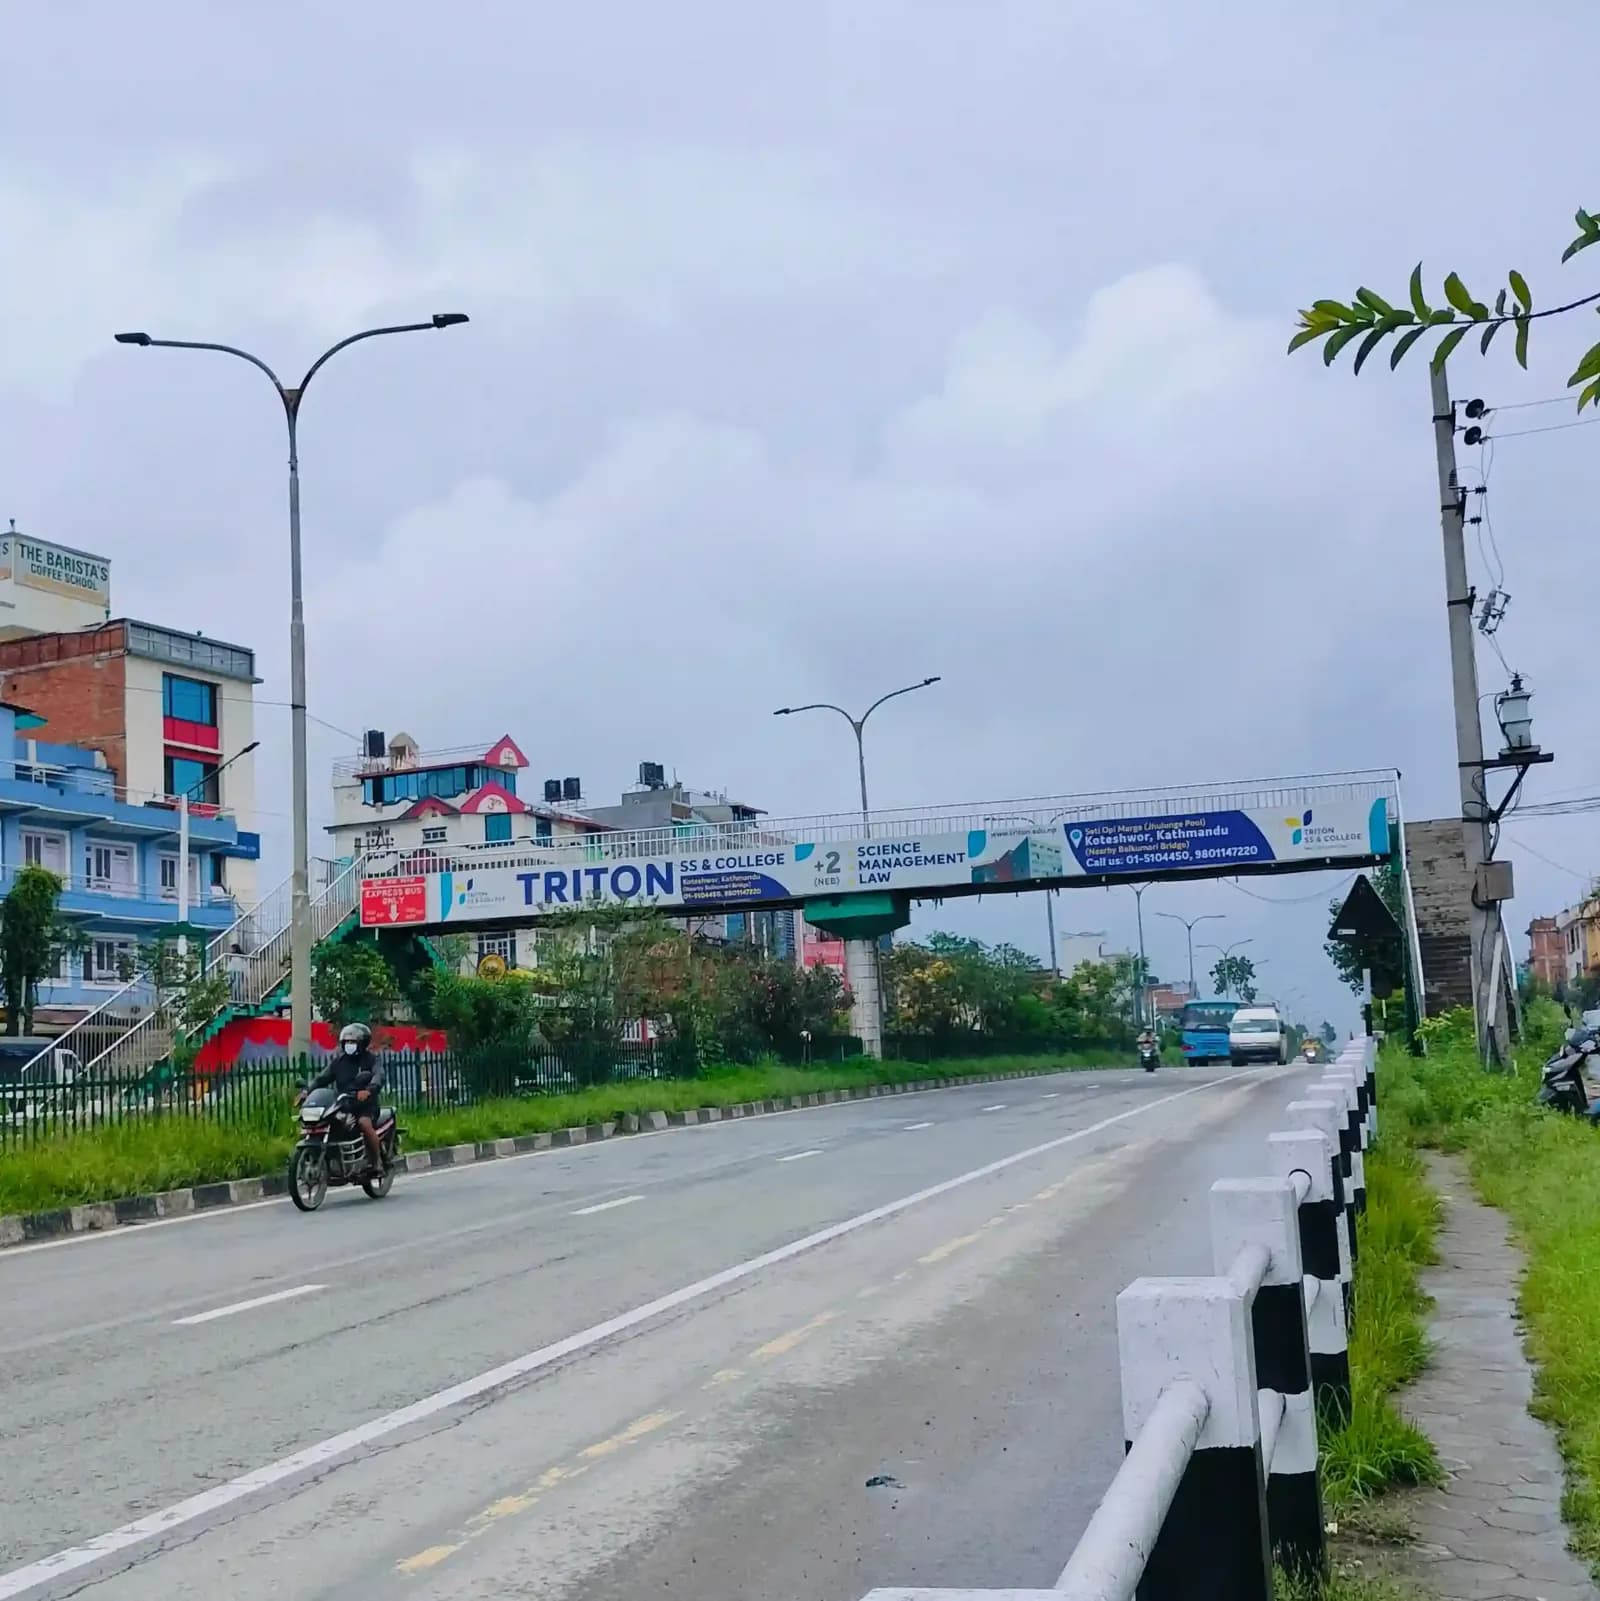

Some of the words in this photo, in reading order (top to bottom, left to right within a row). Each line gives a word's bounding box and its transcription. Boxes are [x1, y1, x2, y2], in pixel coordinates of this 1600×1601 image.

[19, 543, 42, 563] THE
[46, 551, 108, 581] BARISTA'S
[31, 563, 61, 581] COFFEE
[65, 572, 99, 591] SCHOOL
[1085, 833, 1154, 846] Koteshwor,
[1156, 825, 1229, 840] Kathmandu
[1304, 827, 1335, 836] TRITON
[1304, 836, 1314, 844] SS
[1323, 833, 1362, 842] COLLEGE
[857, 842, 921, 857] SCIENCE
[1086, 857, 1106, 868] Call
[1126, 851, 1193, 865] 01-5104450,
[1195, 845, 1258, 859] 9801147220
[680, 860, 697, 873] SS
[702, 858, 712, 871] &
[715, 853, 785, 869] COLLEGE
[814, 851, 841, 874] +2
[858, 852, 966, 871] MANAGEMENT
[516, 861, 674, 905] TRITON
[814, 876, 841, 887] (NEB)
[859, 871, 891, 885] LAW
[365, 888, 404, 898] EXPRESS
[404, 887, 423, 896] BUS
[382, 896, 405, 905] ONLY
